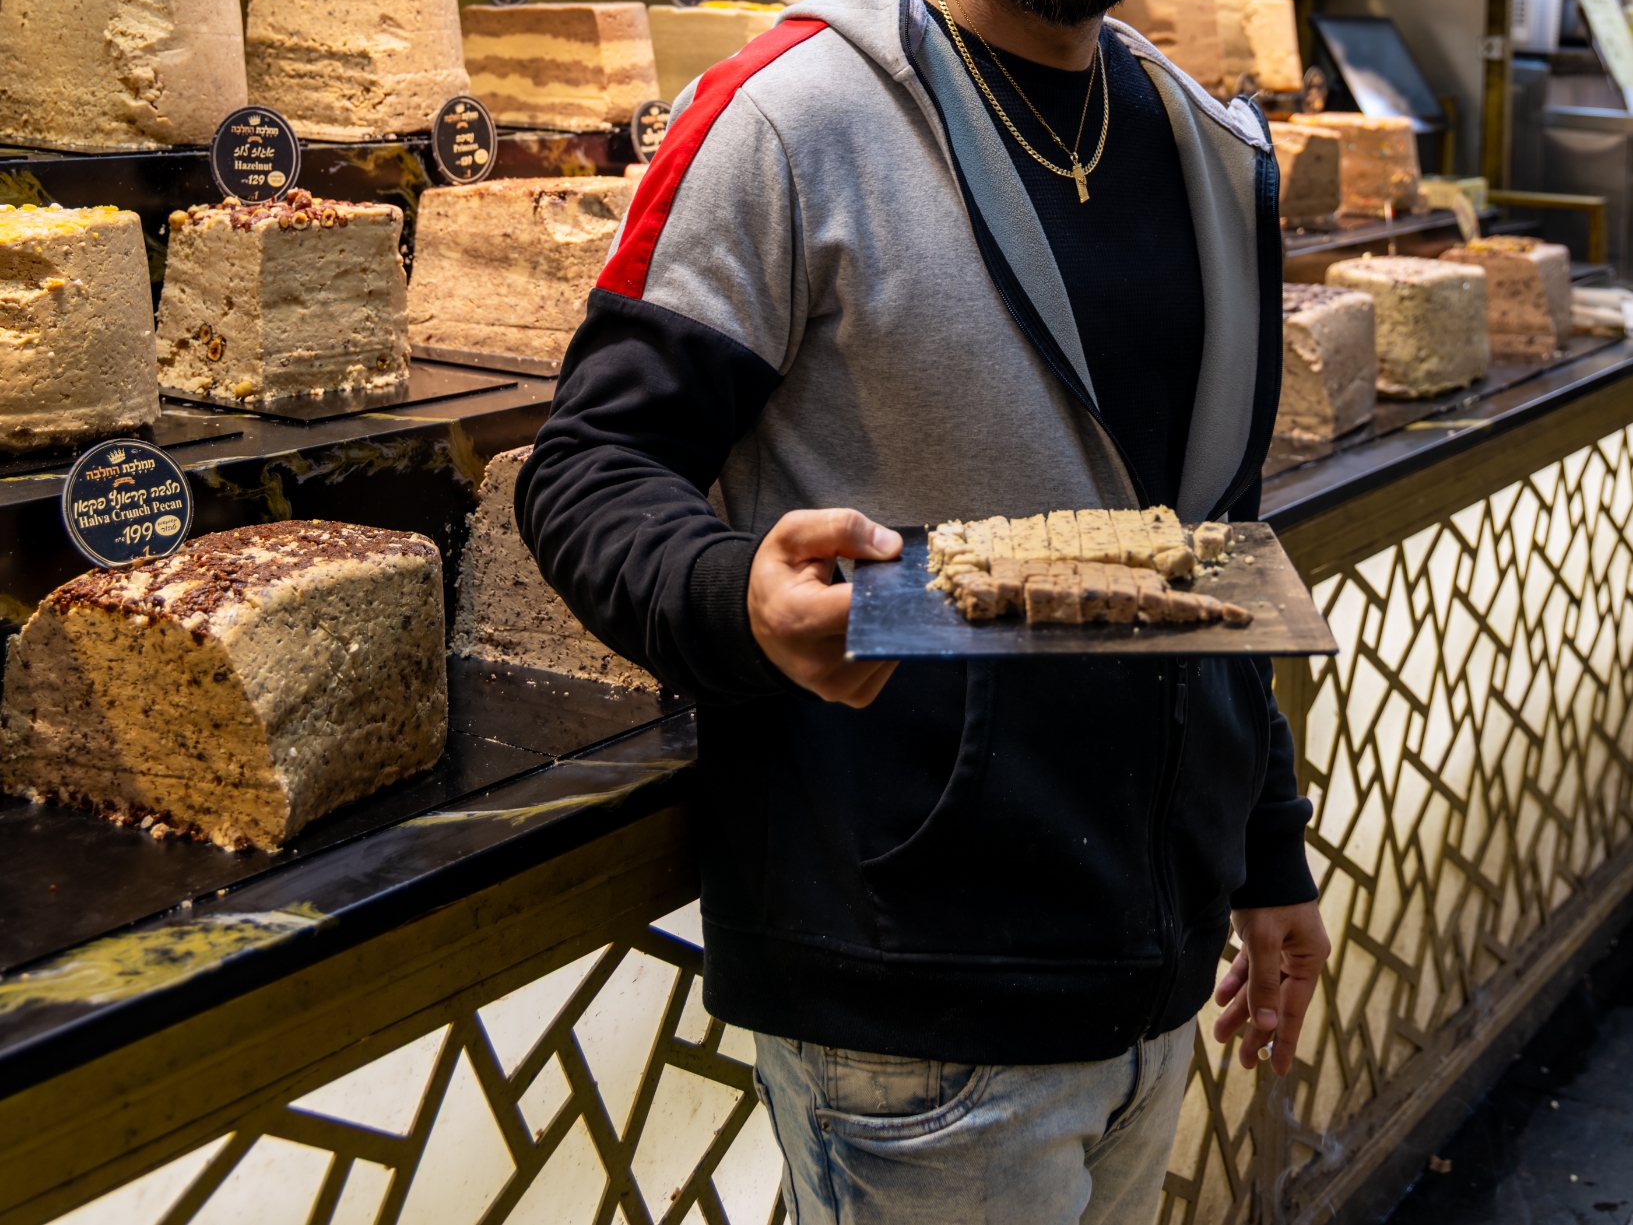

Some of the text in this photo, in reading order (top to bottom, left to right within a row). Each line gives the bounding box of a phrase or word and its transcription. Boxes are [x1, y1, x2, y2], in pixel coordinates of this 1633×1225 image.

[234, 160, 272, 171] Hazelnut
[248, 174, 265, 185] 129
[150, 479, 181, 498] חלבה
[74, 497, 106, 519] פקאן
[79, 499, 183, 529] Halva Crunch Pecan
[123, 521, 153, 545] 199
